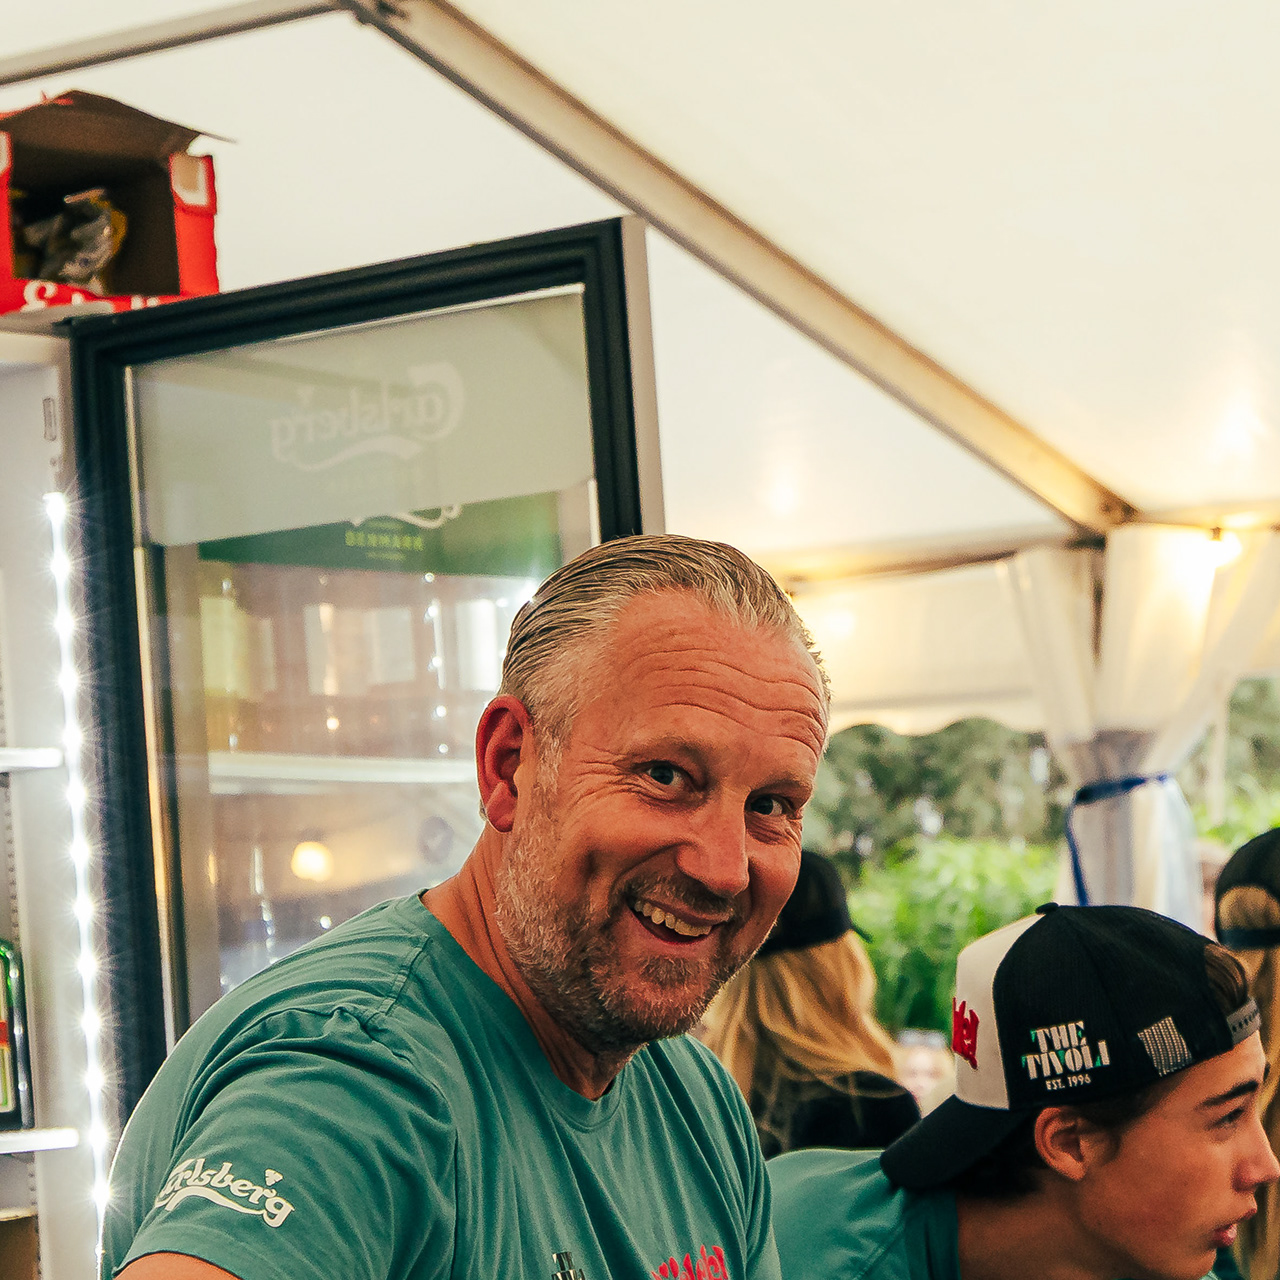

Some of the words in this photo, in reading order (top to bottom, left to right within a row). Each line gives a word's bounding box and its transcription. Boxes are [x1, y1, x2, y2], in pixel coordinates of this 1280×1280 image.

[1030, 1021, 1087, 1053] THE
[1021, 1040, 1111, 1080] TIVOLI
[1045, 1076, 1066, 1091] EST.
[1068, 1073, 1092, 1088] 1996
[154, 1157, 296, 1229] Carlsberg
